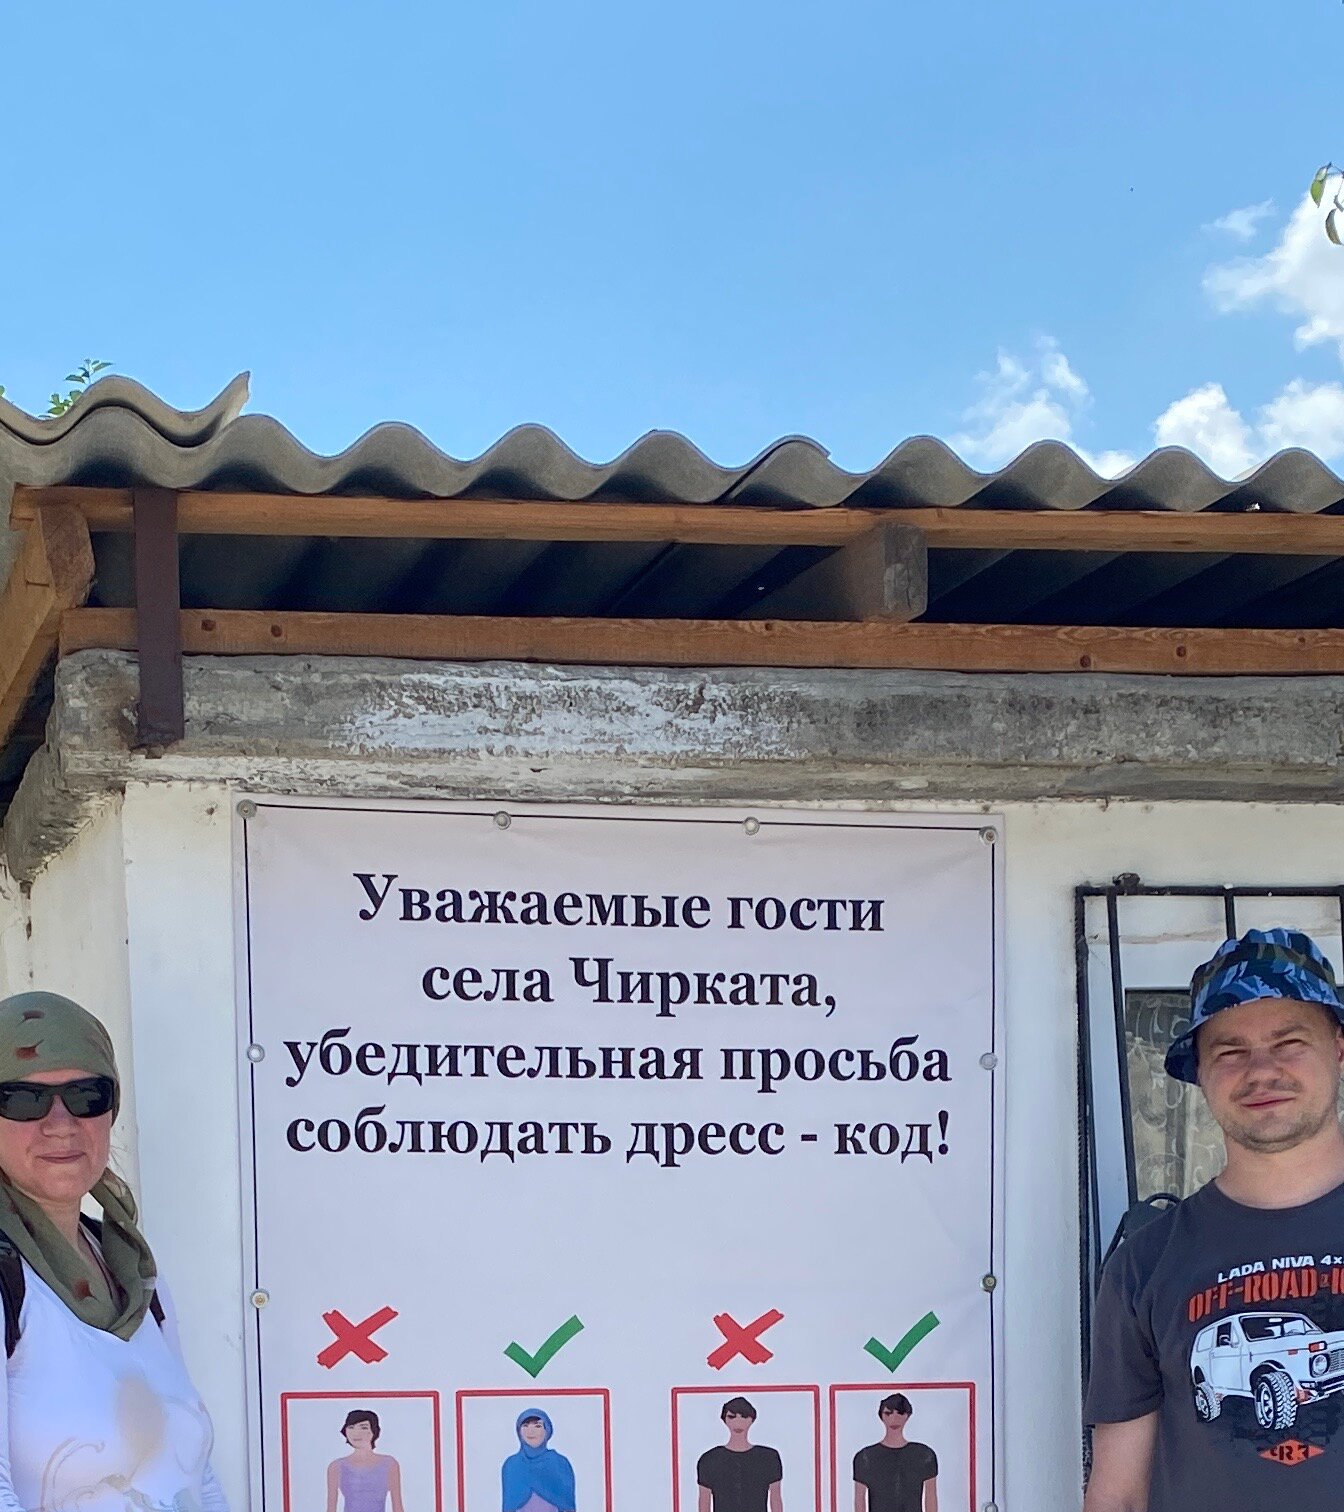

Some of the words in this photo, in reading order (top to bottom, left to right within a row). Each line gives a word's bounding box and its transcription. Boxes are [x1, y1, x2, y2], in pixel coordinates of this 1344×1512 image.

[353, 872, 711, 930] Уважаемые
[726, 896, 885, 932] гости
[421, 965, 555, 1003] села
[568, 956, 837, 1018] Чирката,
[283, 1027, 704, 1088] убедительная
[719, 1034, 953, 1094] просьба
[285, 1104, 612, 1164] соблюдать
[625, 1122, 786, 1168] дресс
[833, 1109, 950, 1165] код!
[1218, 1261, 1265, 1283] LADA
[1272, 1255, 1315, 1270] NIVA
